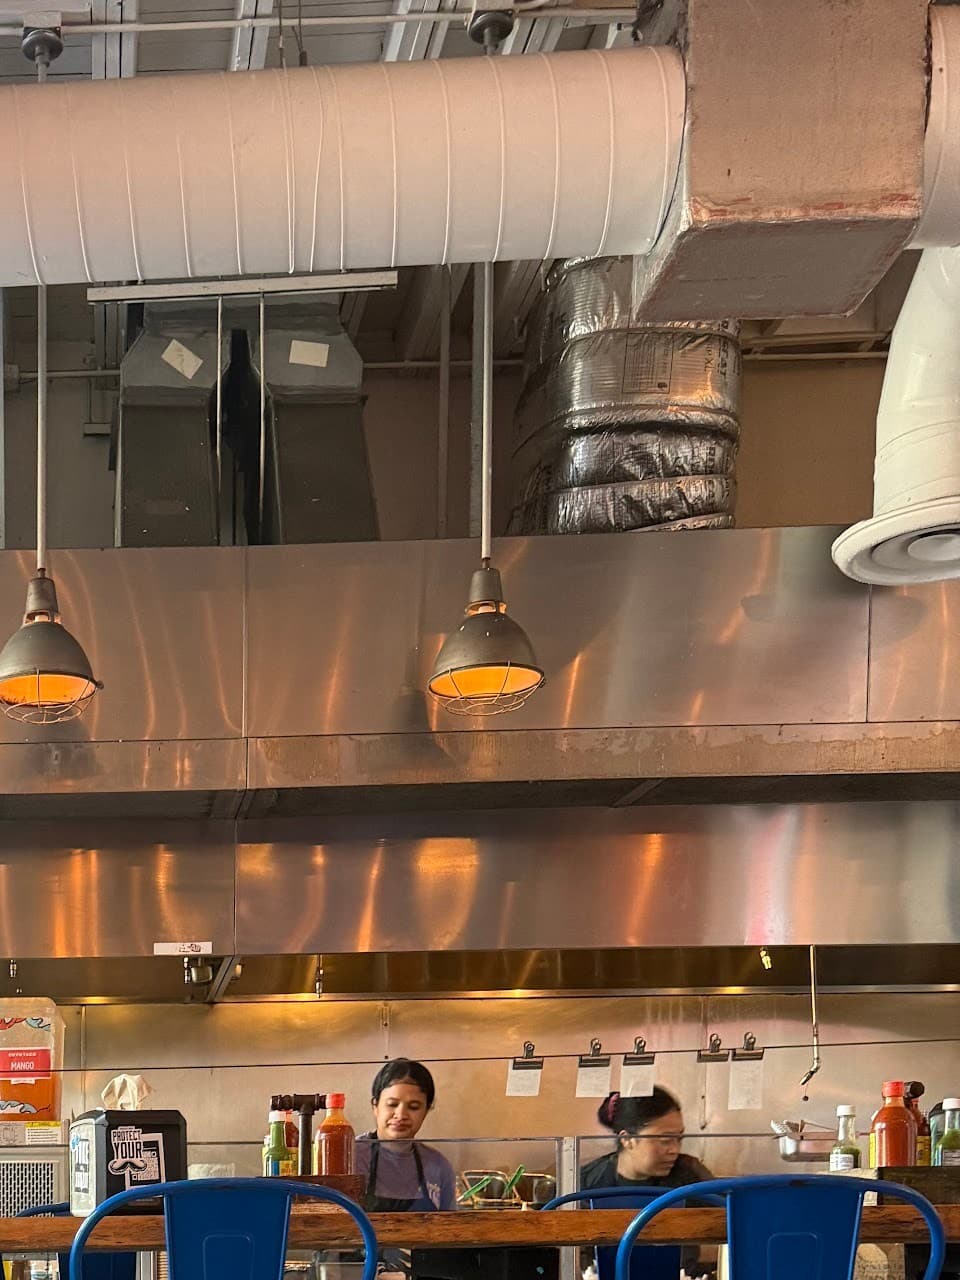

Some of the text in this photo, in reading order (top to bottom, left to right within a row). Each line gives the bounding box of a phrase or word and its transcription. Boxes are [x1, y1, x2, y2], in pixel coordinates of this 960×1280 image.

[10, 1061, 35, 1071] MANGO
[112, 1130, 141, 1141] PROTECT
[113, 1141, 142, 1159] YOUR
